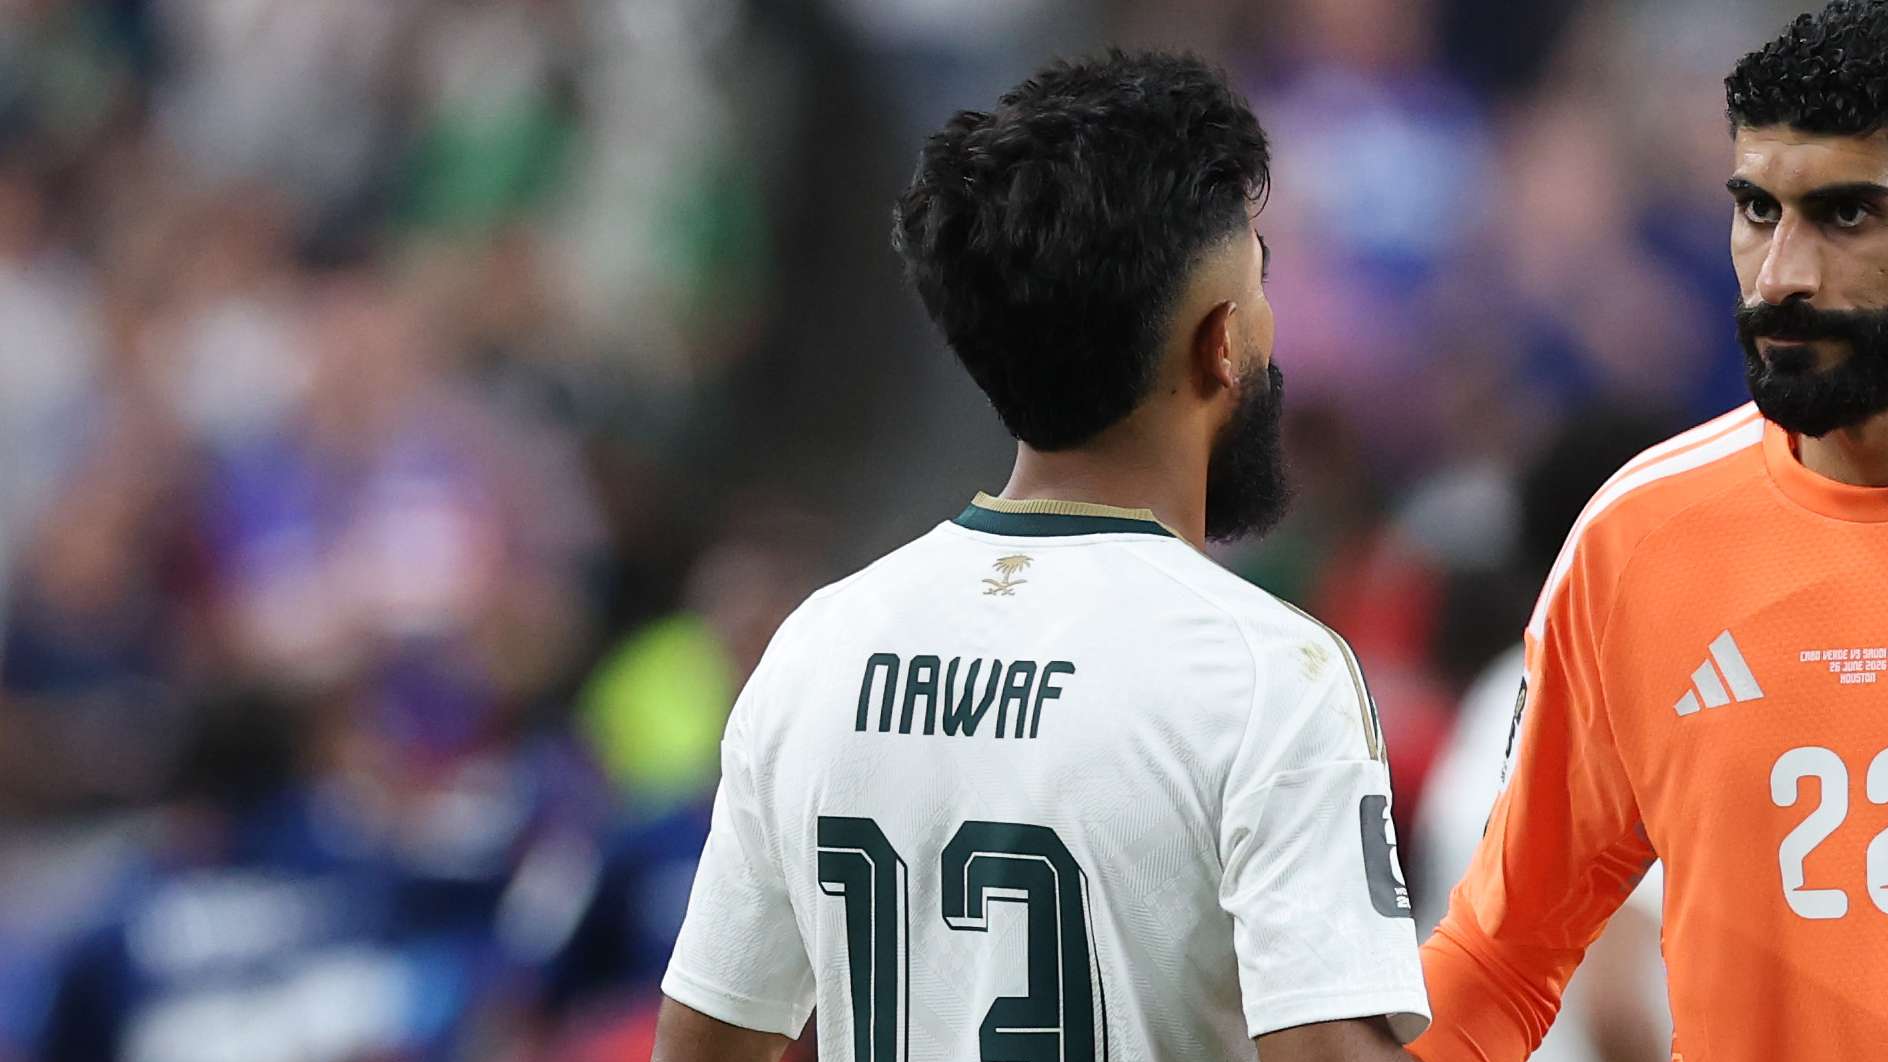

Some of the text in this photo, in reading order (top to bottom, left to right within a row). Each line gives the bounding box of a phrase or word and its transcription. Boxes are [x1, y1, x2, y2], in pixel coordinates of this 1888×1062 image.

[1822, 649, 1849, 661] VERDE
[1850, 648, 1861, 660] VS
[1862, 647, 1887, 659] SAUDI
[1842, 660, 1864, 672] JUNE
[1865, 659, 1887, 671] 2026
[1840, 672, 1877, 684] HOUSTON
[854, 652, 1076, 739] NAWAF
